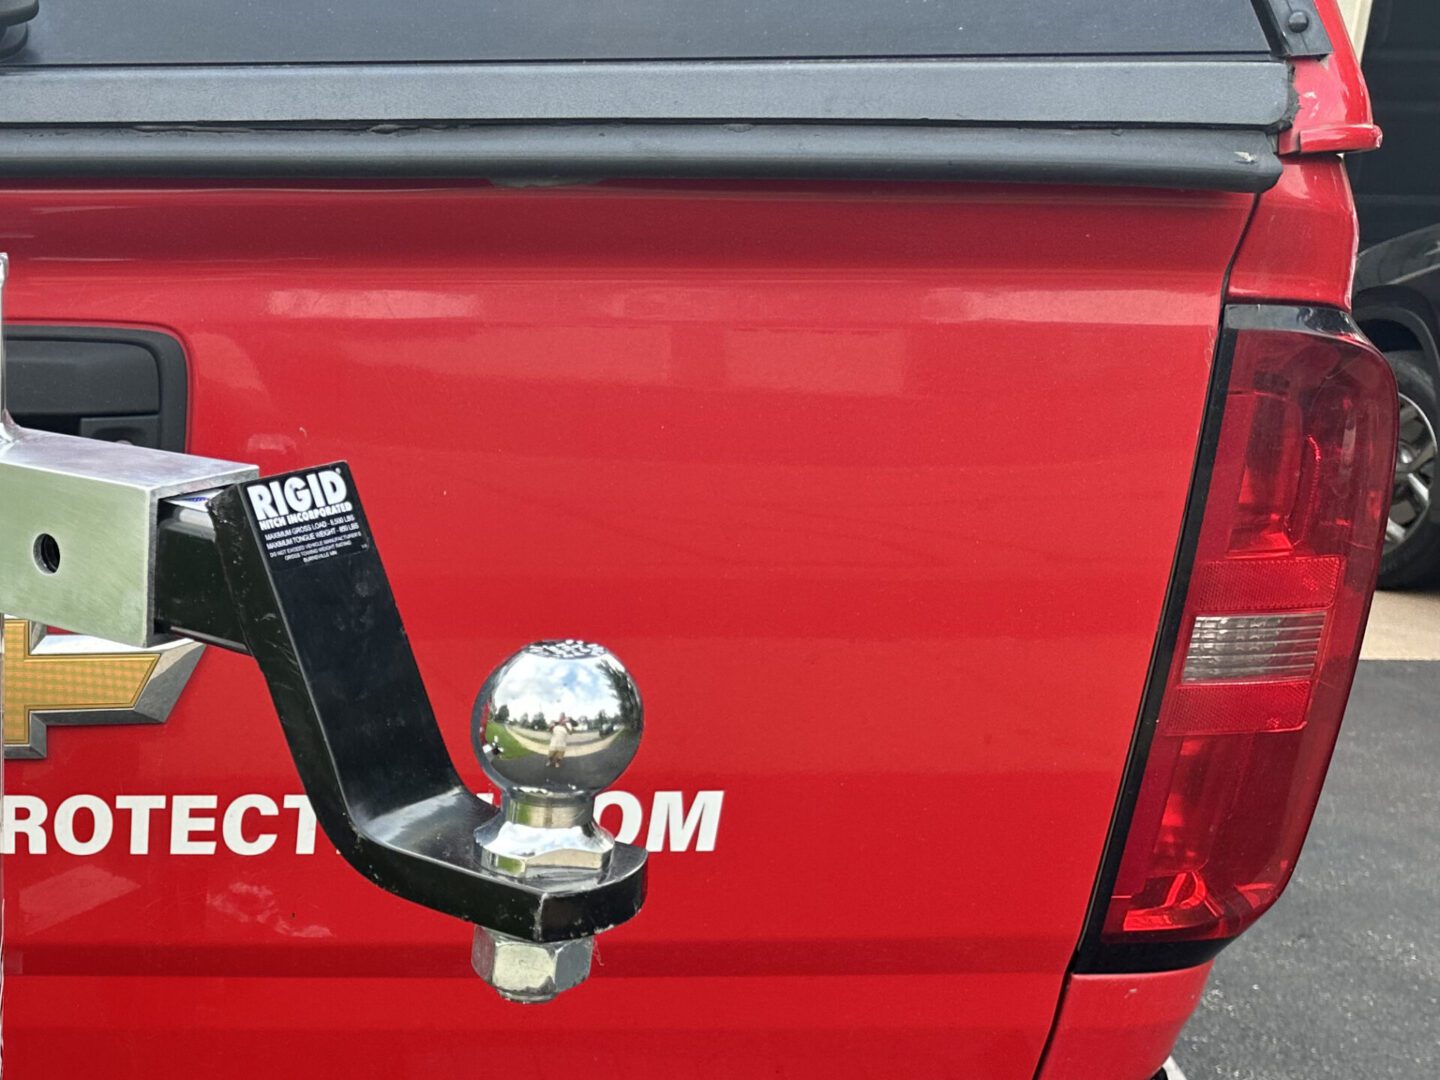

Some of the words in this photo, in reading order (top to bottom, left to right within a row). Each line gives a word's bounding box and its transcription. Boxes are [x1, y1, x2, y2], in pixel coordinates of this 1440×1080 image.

[247, 470, 347, 520] RIGID
[259, 516, 287, 531] HITCH
[287, 501, 353, 525] INCORPORATED
